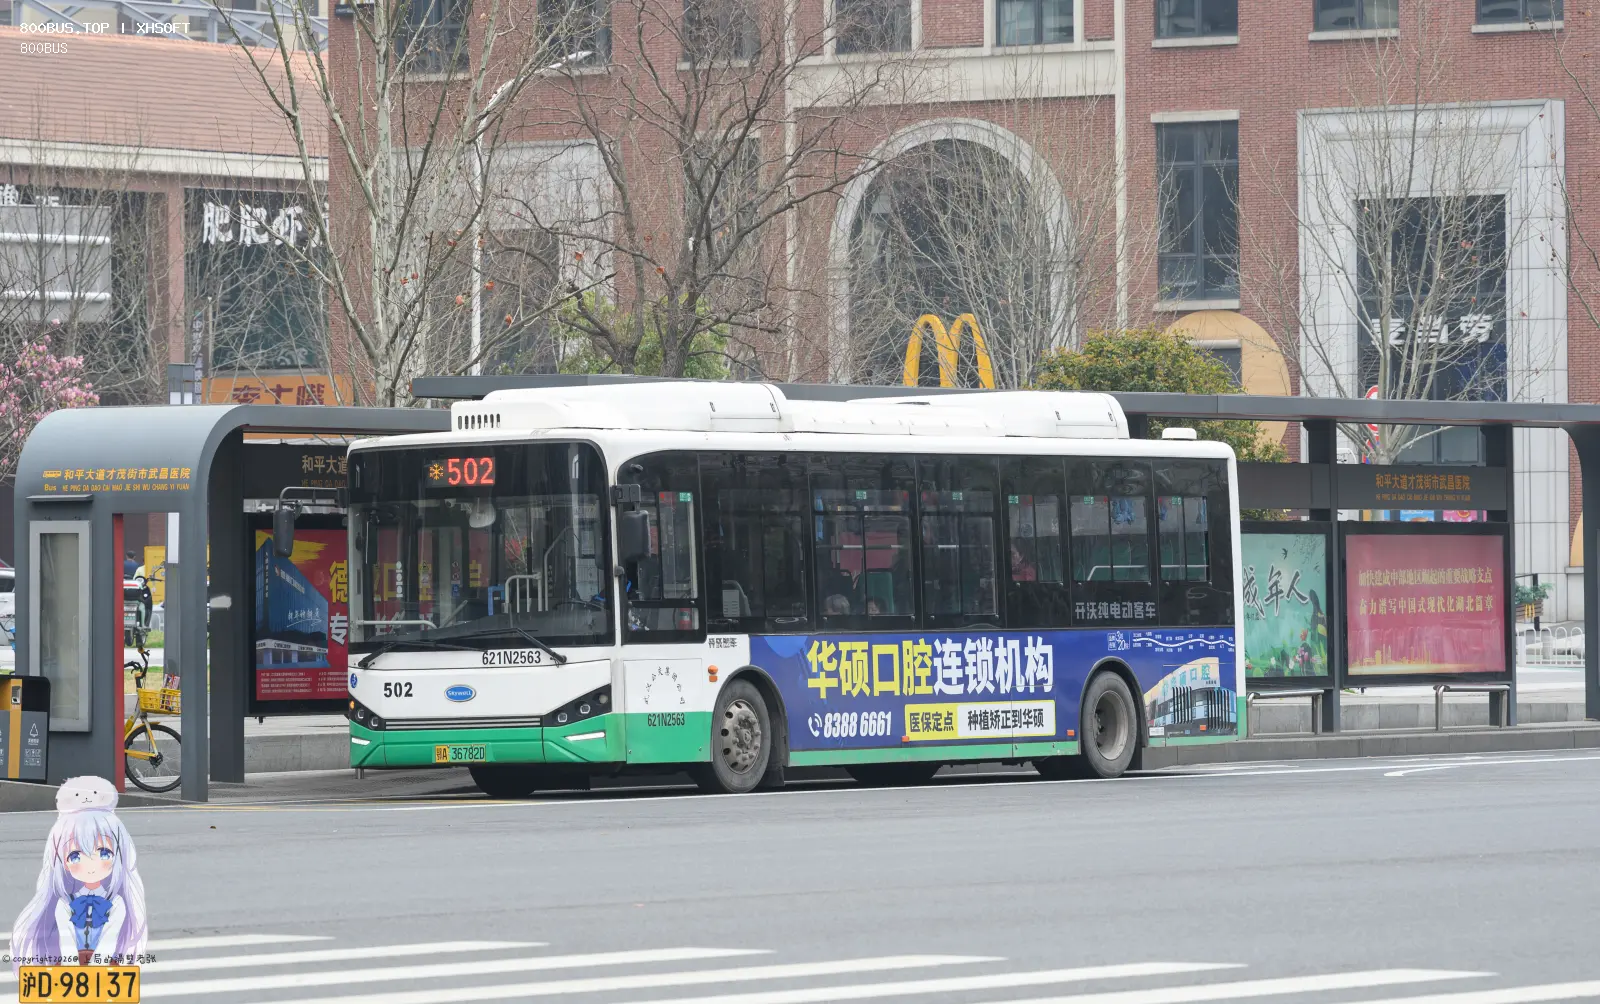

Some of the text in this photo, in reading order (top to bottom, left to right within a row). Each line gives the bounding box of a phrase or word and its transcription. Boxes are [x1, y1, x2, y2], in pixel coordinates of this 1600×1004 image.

[63, 467, 191, 481] 和平大道才茂街市武昌医院
[447, 457, 494, 486] 502
[1375, 473, 1471, 490] 和平大道才茂街市武昌医院
[1075, 601, 1156, 620] 开沃纯电动客车
[1359, 594, 1493, 616] 奋力谱写中国式现代化湖北篇章
[482, 651, 541, 665] 621N2563
[807, 636, 1054, 699] 华硕口腔连锁机构
[383, 681, 413, 698] 502
[647, 712, 685, 727] 621N2563
[823, 711, 892, 738] 8388 6661
[909, 708, 1044, 733] 医保定点 种植矫正到华硕
